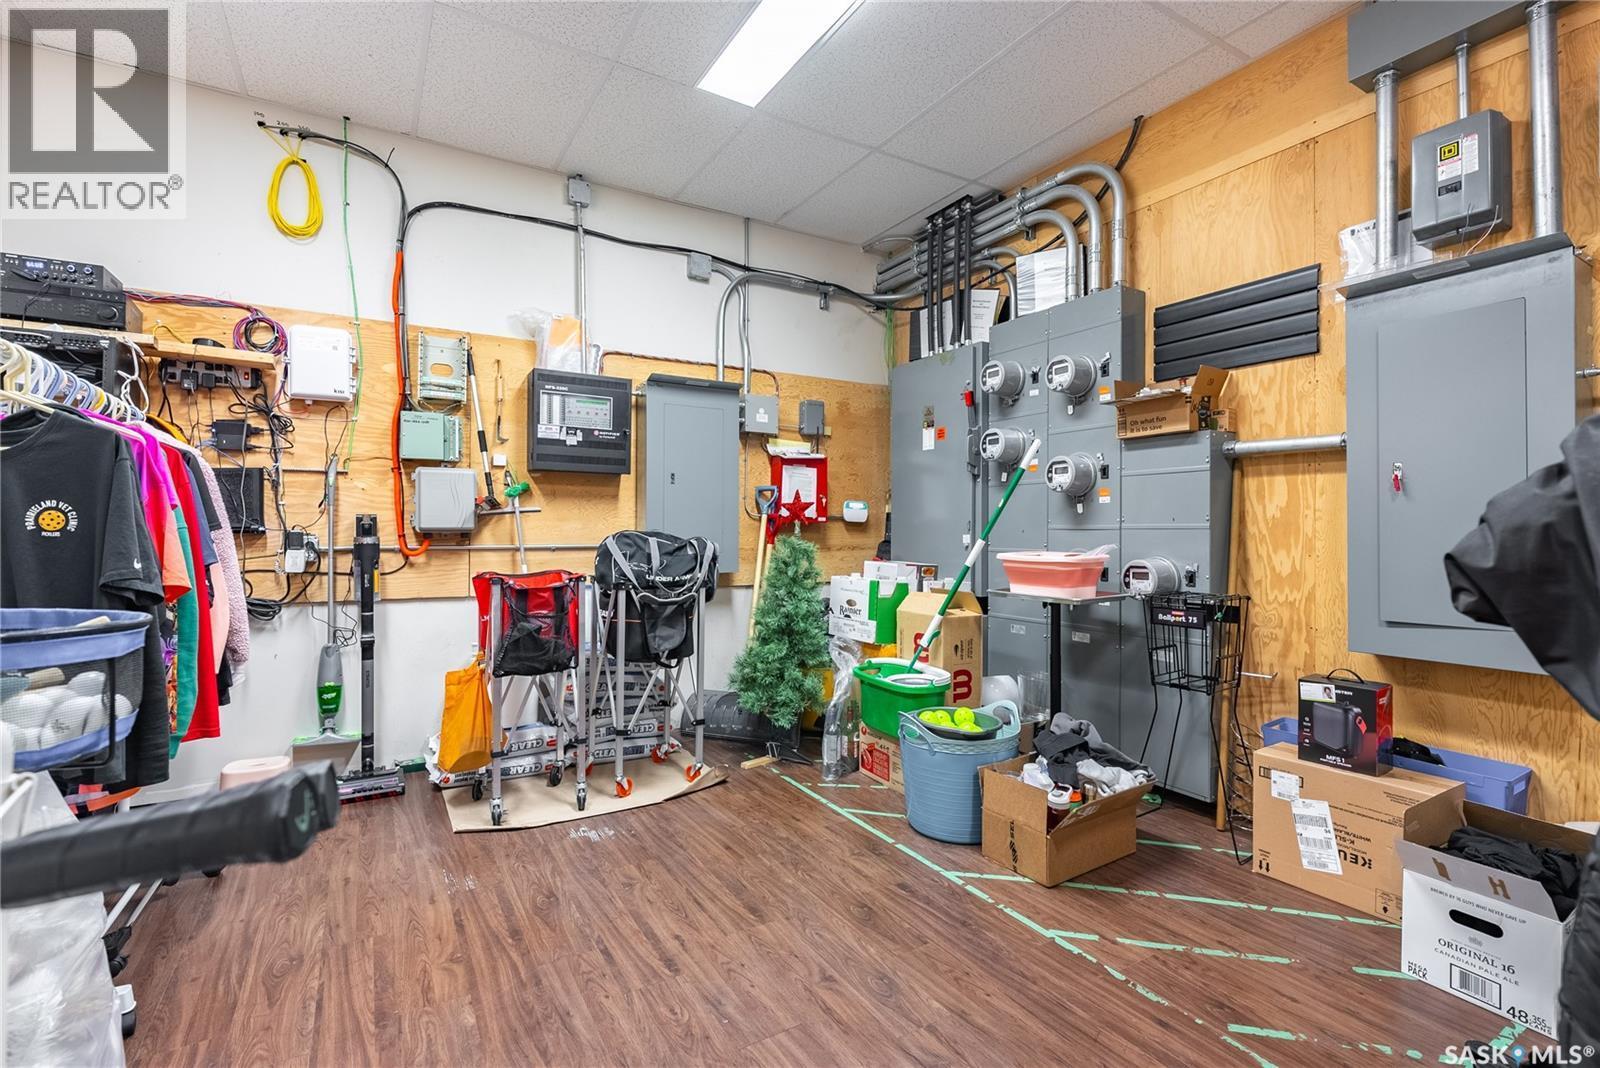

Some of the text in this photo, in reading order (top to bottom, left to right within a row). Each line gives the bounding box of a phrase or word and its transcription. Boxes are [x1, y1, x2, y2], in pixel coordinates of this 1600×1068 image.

[1139, 417, 1156, 425] what
[1156, 415, 1167, 423] fun
[59, 501, 73, 512] VET
[1188, 616, 1198, 624] 75
[509, 762, 542, 776] CLEAR
[1462, 898, 1475, 907] GUYS
[1475, 903, 1487, 911] WHO
[1488, 907, 1504, 917] NEVER
[1504, 914, 1518, 922] GAVE
[1438, 937, 1498, 968] ORIGINAL
[1501, 964, 1516, 975] 16
[1408, 960, 1428, 972] MEGA
[1408, 964, 1428, 981] PACK
[1434, 947, 1476, 969] CANADIAN
[1478, 966, 1500, 978] PALE
[1503, 976, 1520, 986] ALE
[1506, 1006, 1529, 1025] 48
[1528, 1023, 1552, 1036] CANS
